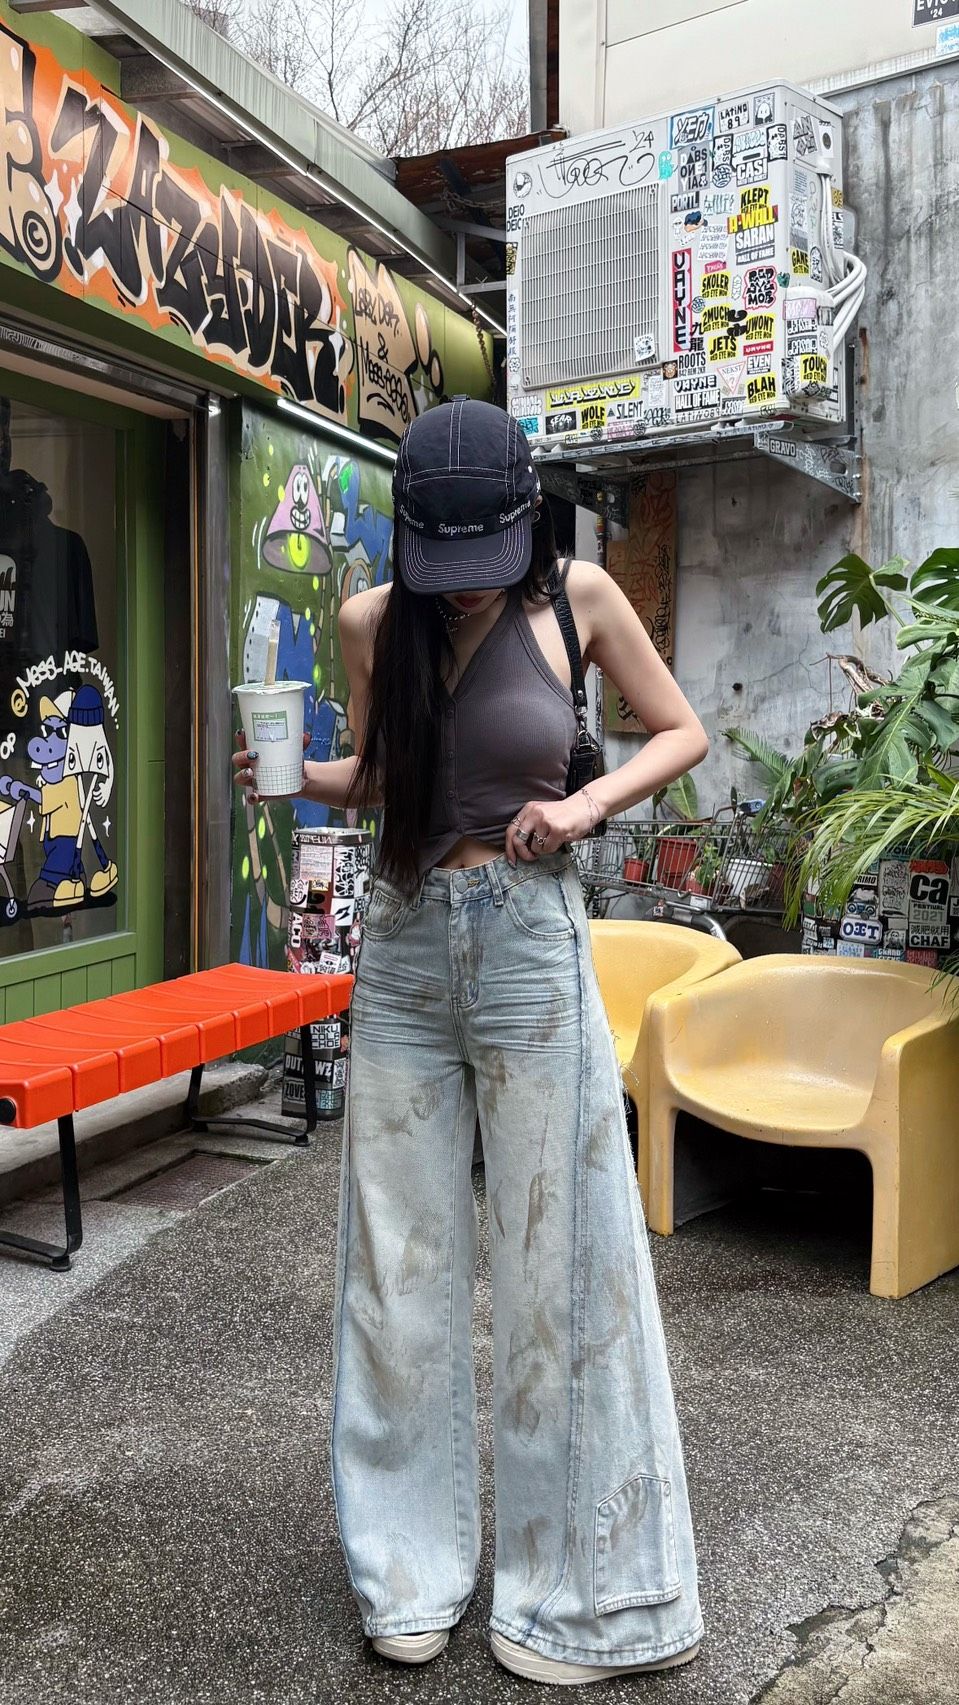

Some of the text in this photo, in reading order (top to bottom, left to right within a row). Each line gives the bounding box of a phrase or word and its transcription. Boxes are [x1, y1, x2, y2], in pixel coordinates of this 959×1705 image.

[679, 351, 706, 372] ROOTS
[747, 376, 776, 399] BLAH
[581, 406, 605, 424] WOLF
[438, 523, 484, 536] Supreme
[499, 500, 532, 525] Supreme
[913, 910, 945, 923] 2021
[910, 935, 949, 947] CHAF
